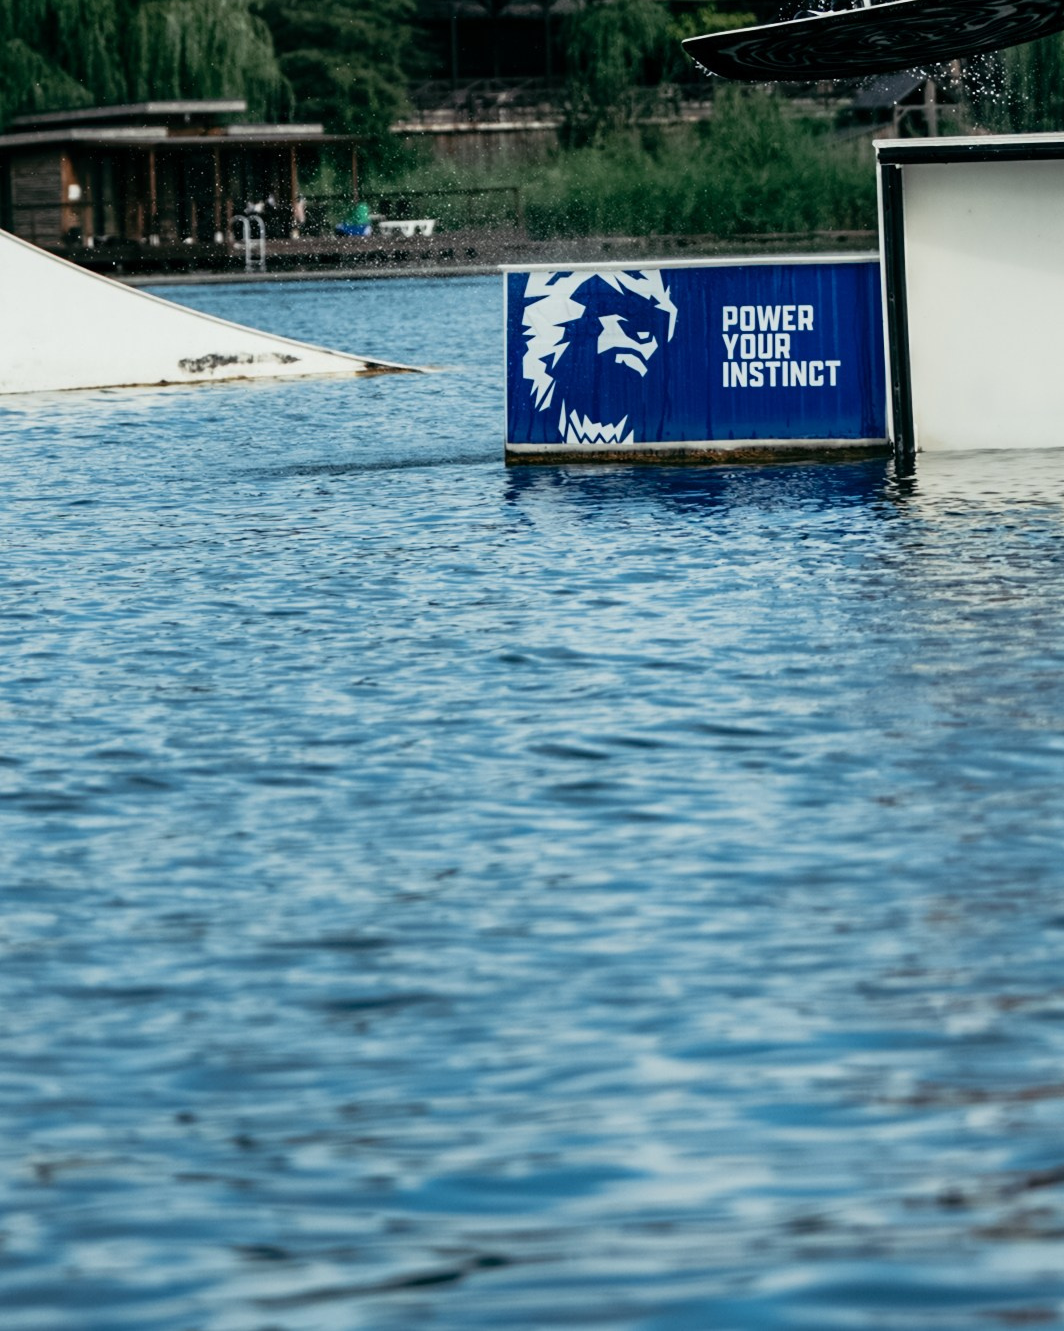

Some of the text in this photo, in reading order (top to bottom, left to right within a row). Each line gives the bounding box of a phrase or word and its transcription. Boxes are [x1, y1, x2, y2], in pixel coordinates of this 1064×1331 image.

[722, 305, 814, 331] POWER
[722, 333, 790, 359] YOUR
[722, 360, 841, 388] INSTINCT
